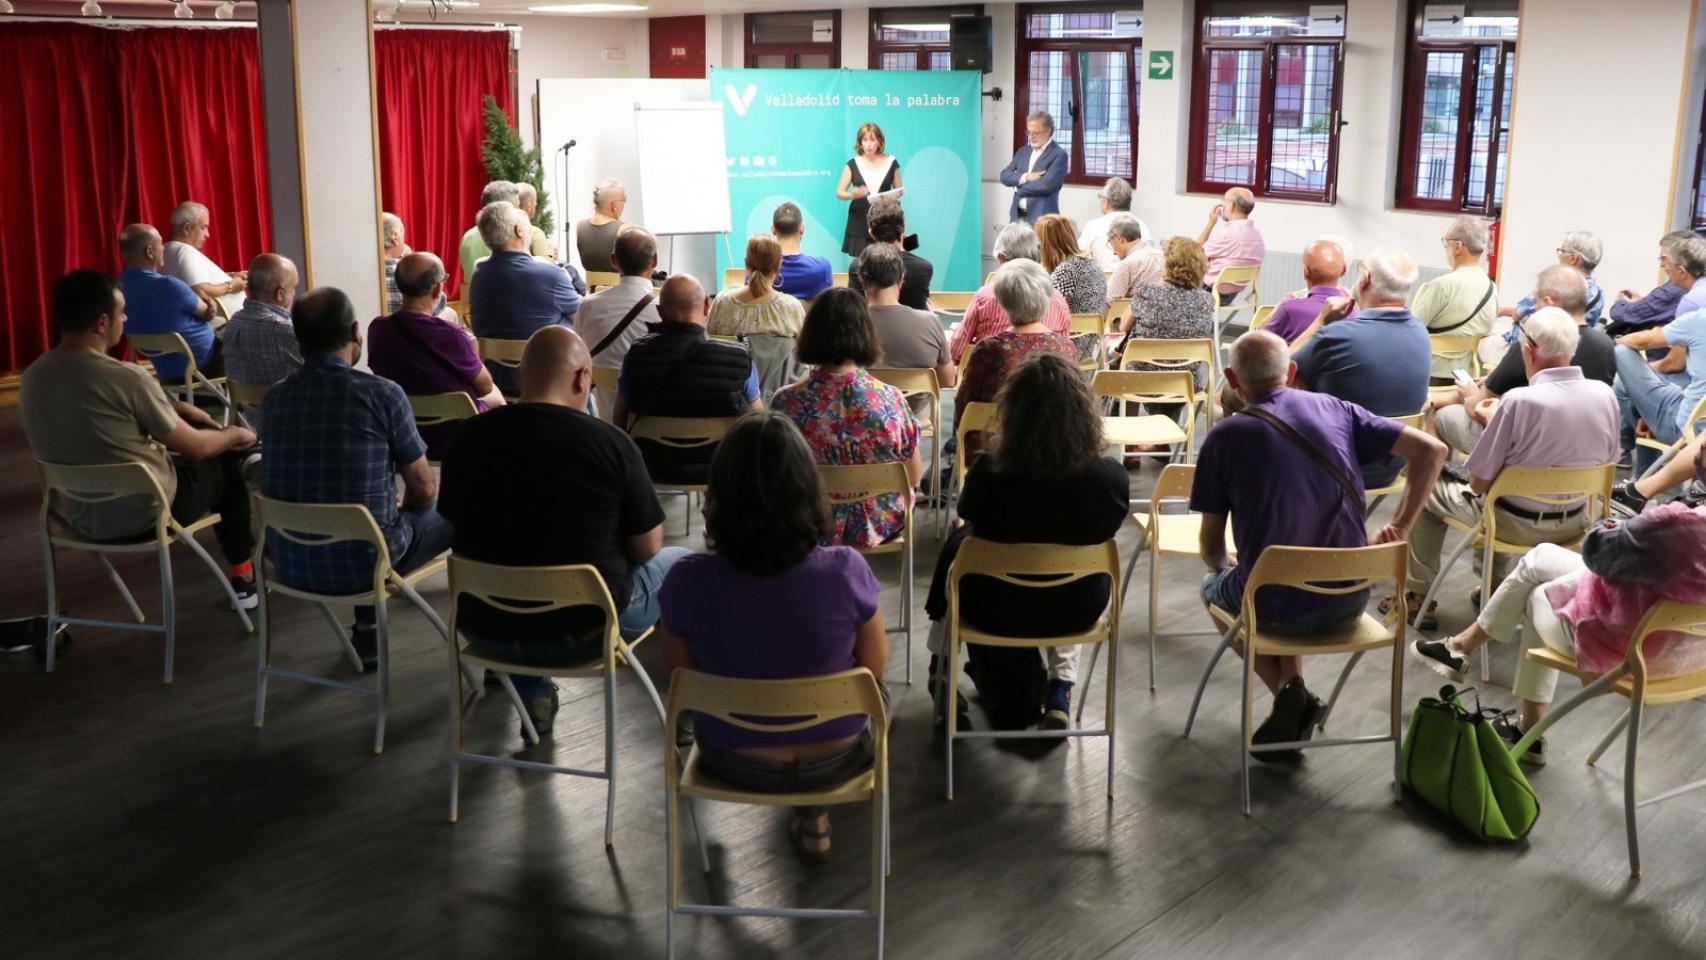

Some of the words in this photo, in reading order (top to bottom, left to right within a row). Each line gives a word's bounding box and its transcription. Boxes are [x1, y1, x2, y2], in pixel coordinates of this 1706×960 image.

[764, 94, 840, 106] Valladolid
[847, 94, 877, 106] toma
[886, 94, 900, 105] la
[907, 93, 960, 108] palabra
